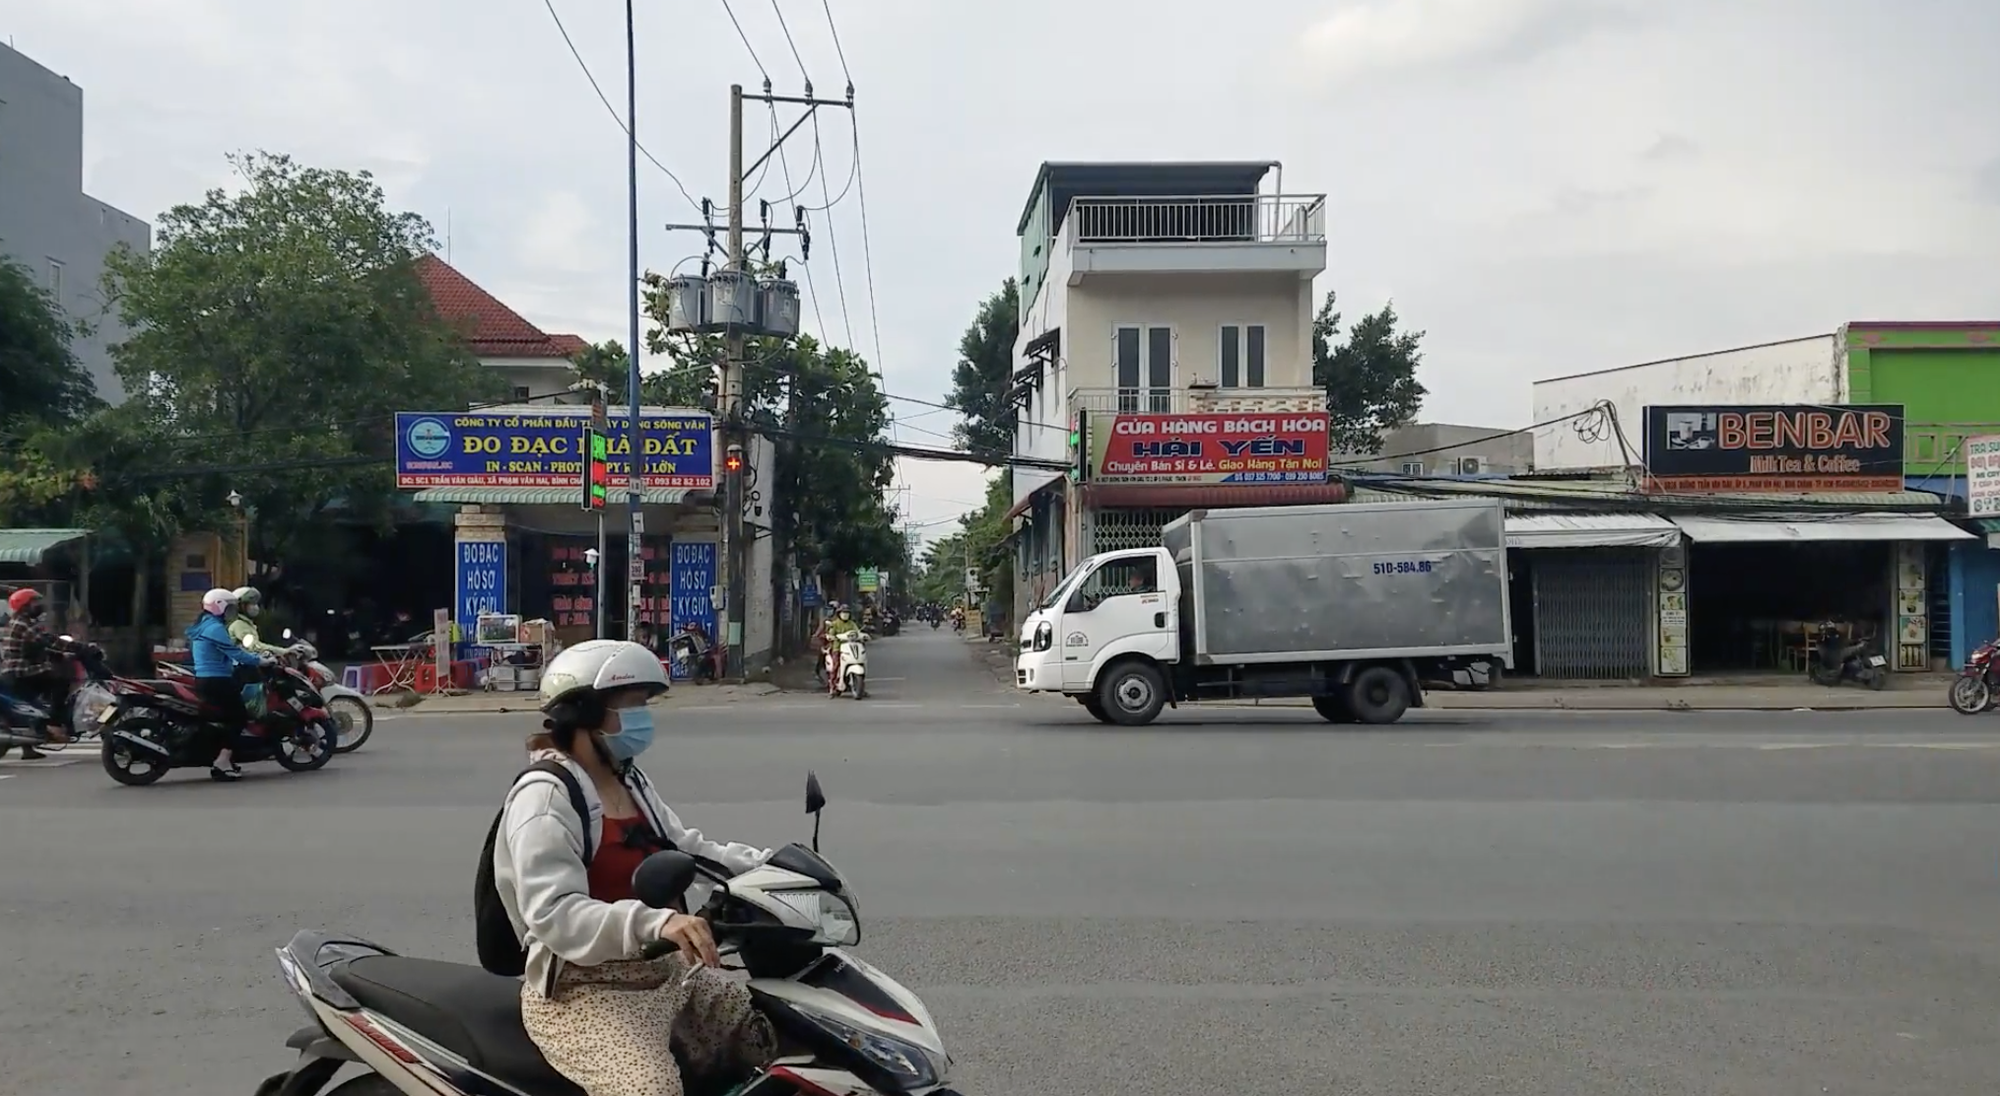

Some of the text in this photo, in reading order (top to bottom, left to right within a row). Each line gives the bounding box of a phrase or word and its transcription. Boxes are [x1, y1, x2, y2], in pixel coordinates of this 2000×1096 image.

[454, 416, 485, 427] CÔNG
[487, 418, 501, 428] TY
[653, 418, 682, 431] SÔNG
[1115, 416, 1326, 435] CỬA HÀNG BÁCH HÓA
[1718, 411, 1891, 450] BENBAR
[462, 436, 502, 454] ĐO
[509, 436, 569, 458] ĐẠC
[643, 431, 698, 456] ĐẤT
[1131, 434, 1306, 458] HẢI YẾN
[485, 461, 500, 473] IN
[508, 461, 543, 473] SCAN
[1107, 460, 1148, 474] Chuyên
[1151, 461, 1172, 471] Bán
[1187, 461, 1198, 471] &
[1218, 459, 1244, 471] Giao
[1247, 458, 1276, 473] Hàng
[1779, 455, 1803, 474] Tea
[1803, 454, 1817, 473] &
[1817, 454, 1861, 473] Coffee
[654, 478, 671, 487] 093
[671, 478, 683, 487] 82
[683, 478, 695, 487] 82
[696, 478, 711, 487] 102
[478, 543, 499, 569] ĐẠC
[690, 544, 711, 569] ĐẠC
[465, 591, 479, 617] KÝ
[677, 591, 690, 617] KÝ
